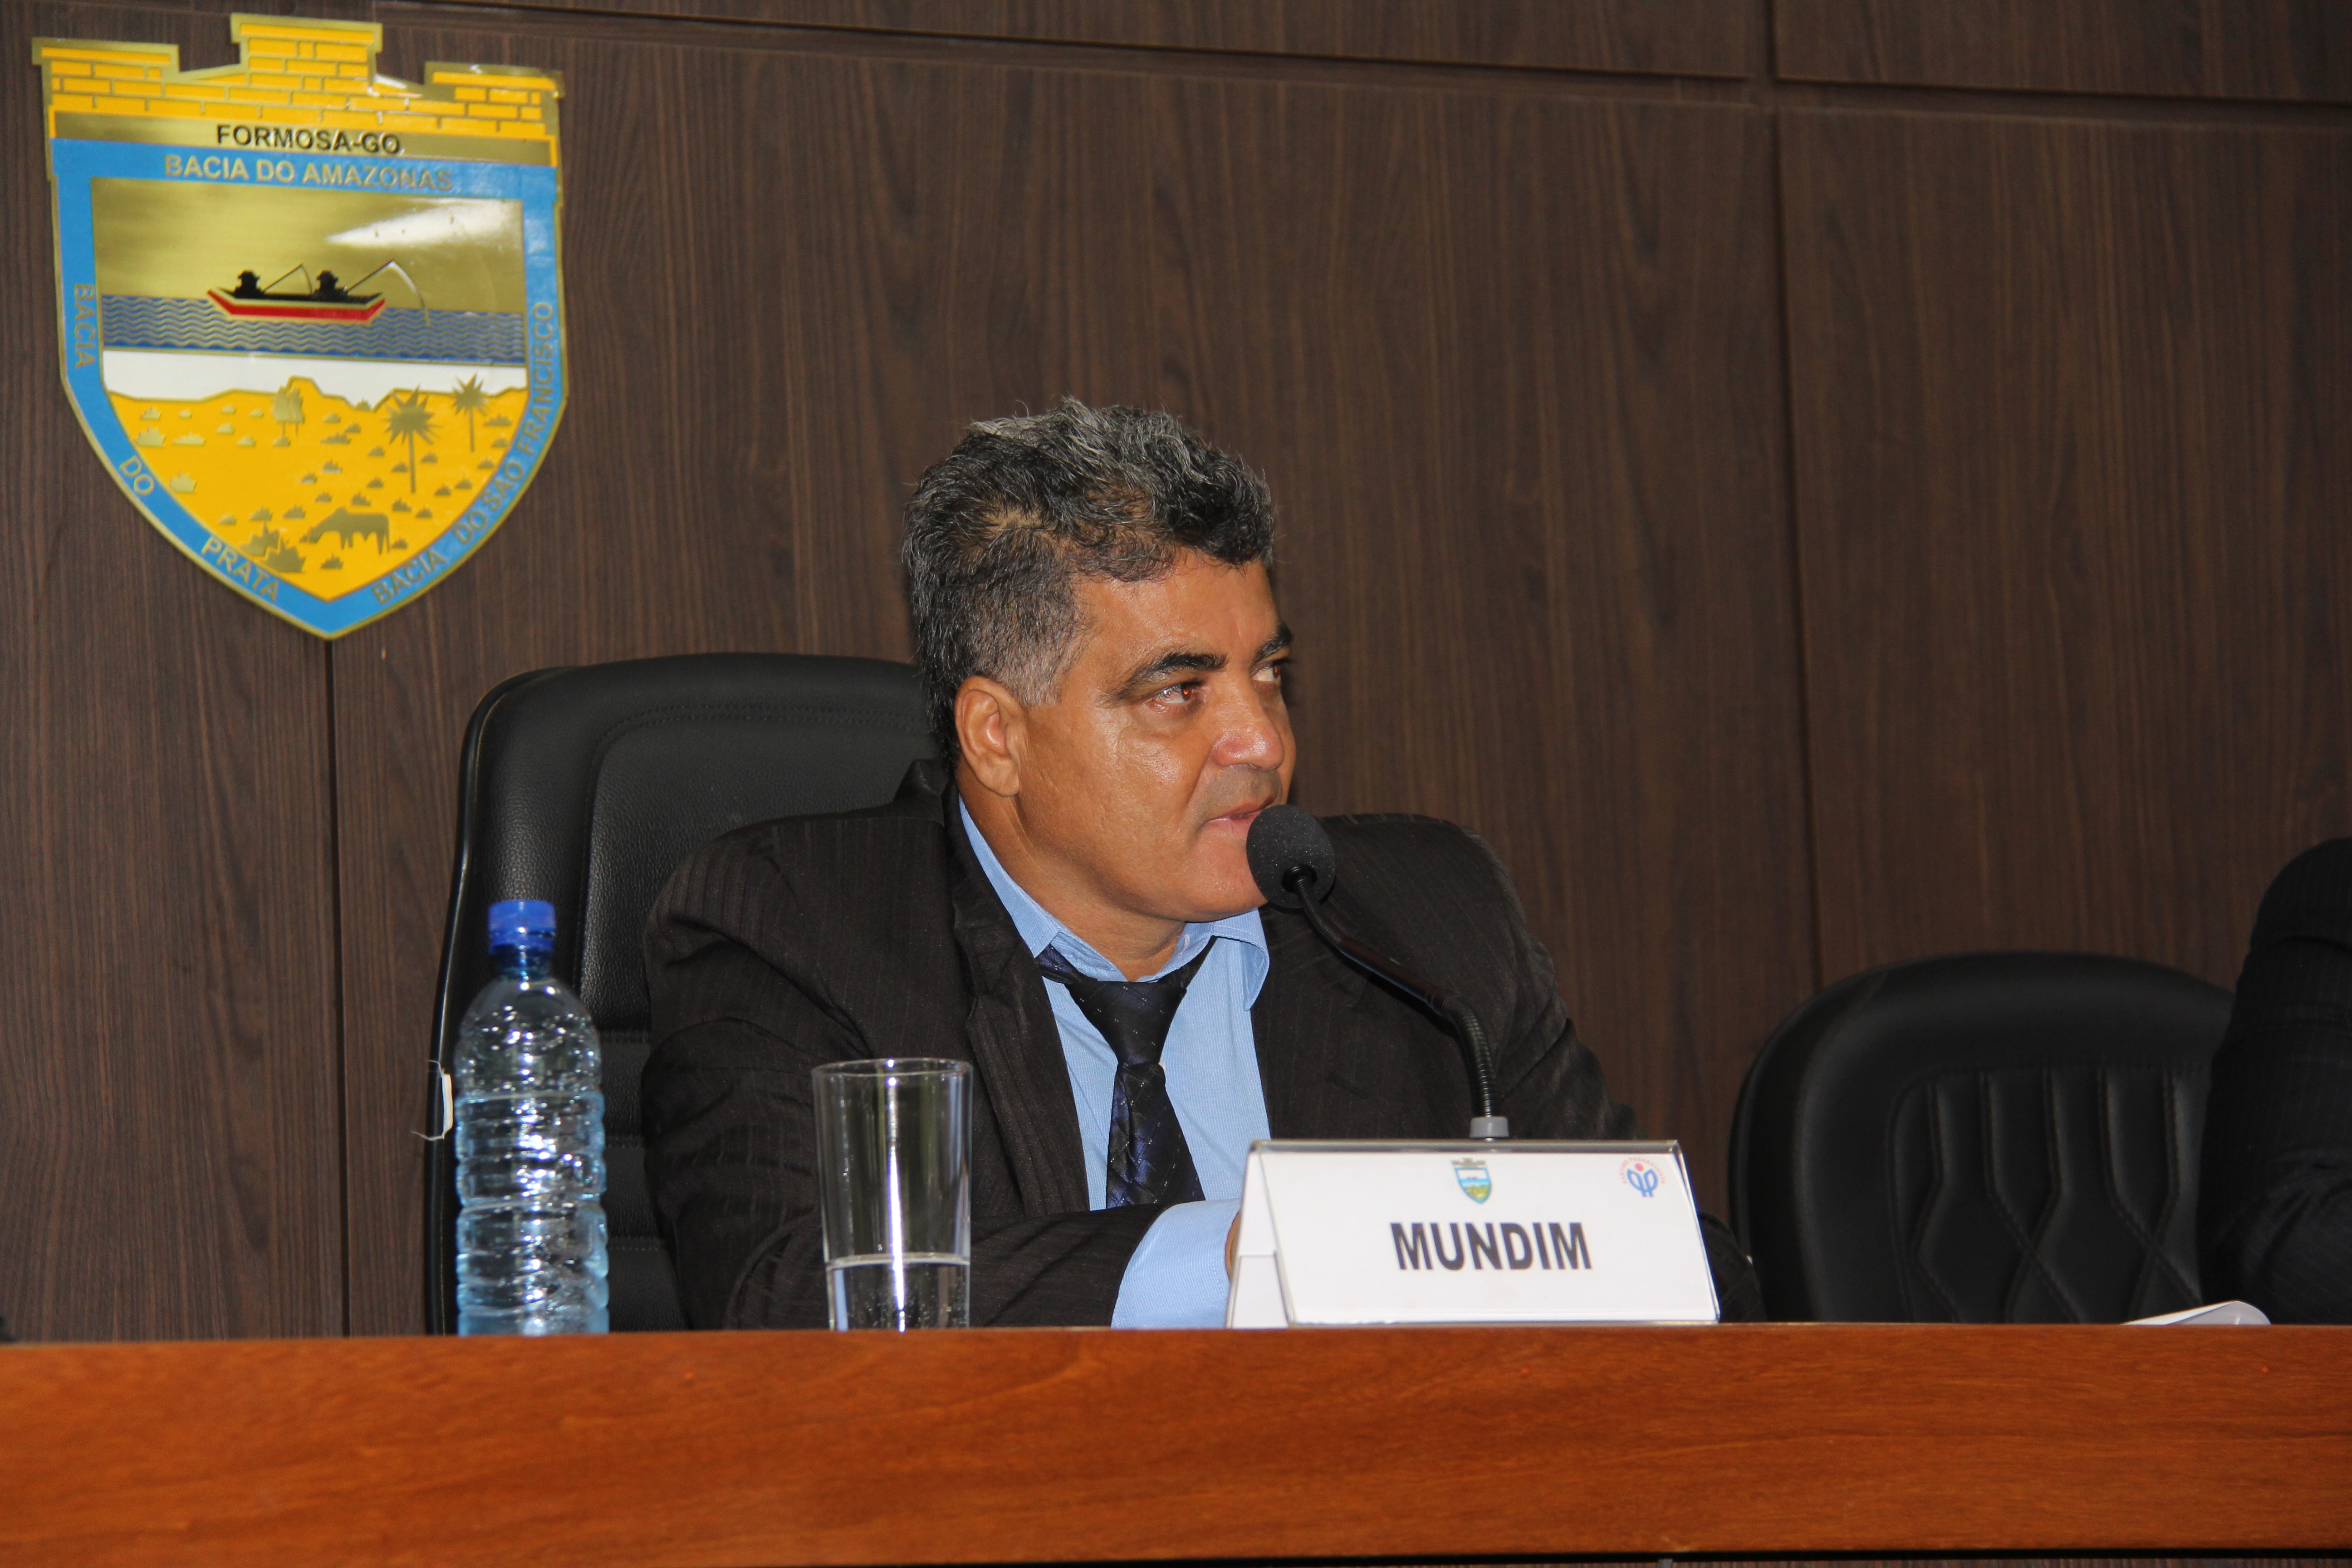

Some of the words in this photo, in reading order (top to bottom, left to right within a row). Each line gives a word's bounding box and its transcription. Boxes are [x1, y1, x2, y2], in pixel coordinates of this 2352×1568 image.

[217, 124, 401, 155] FORMOSA-GO
[164, 155, 250, 181] BACIA
[256, 159, 295, 183] DO
[302, 162, 452, 191] AMAZONAS
[74, 284, 95, 369] BACIA
[119, 456, 155, 495] DO
[201, 536, 279, 603] PRATA
[372, 549, 446, 604] BACIA
[452, 510, 487, 544] DO
[481, 461, 523, 510] SAO
[517, 301, 553, 456] FRANCISCO
[1389, 1222, 1592, 1271] MUNDIM
